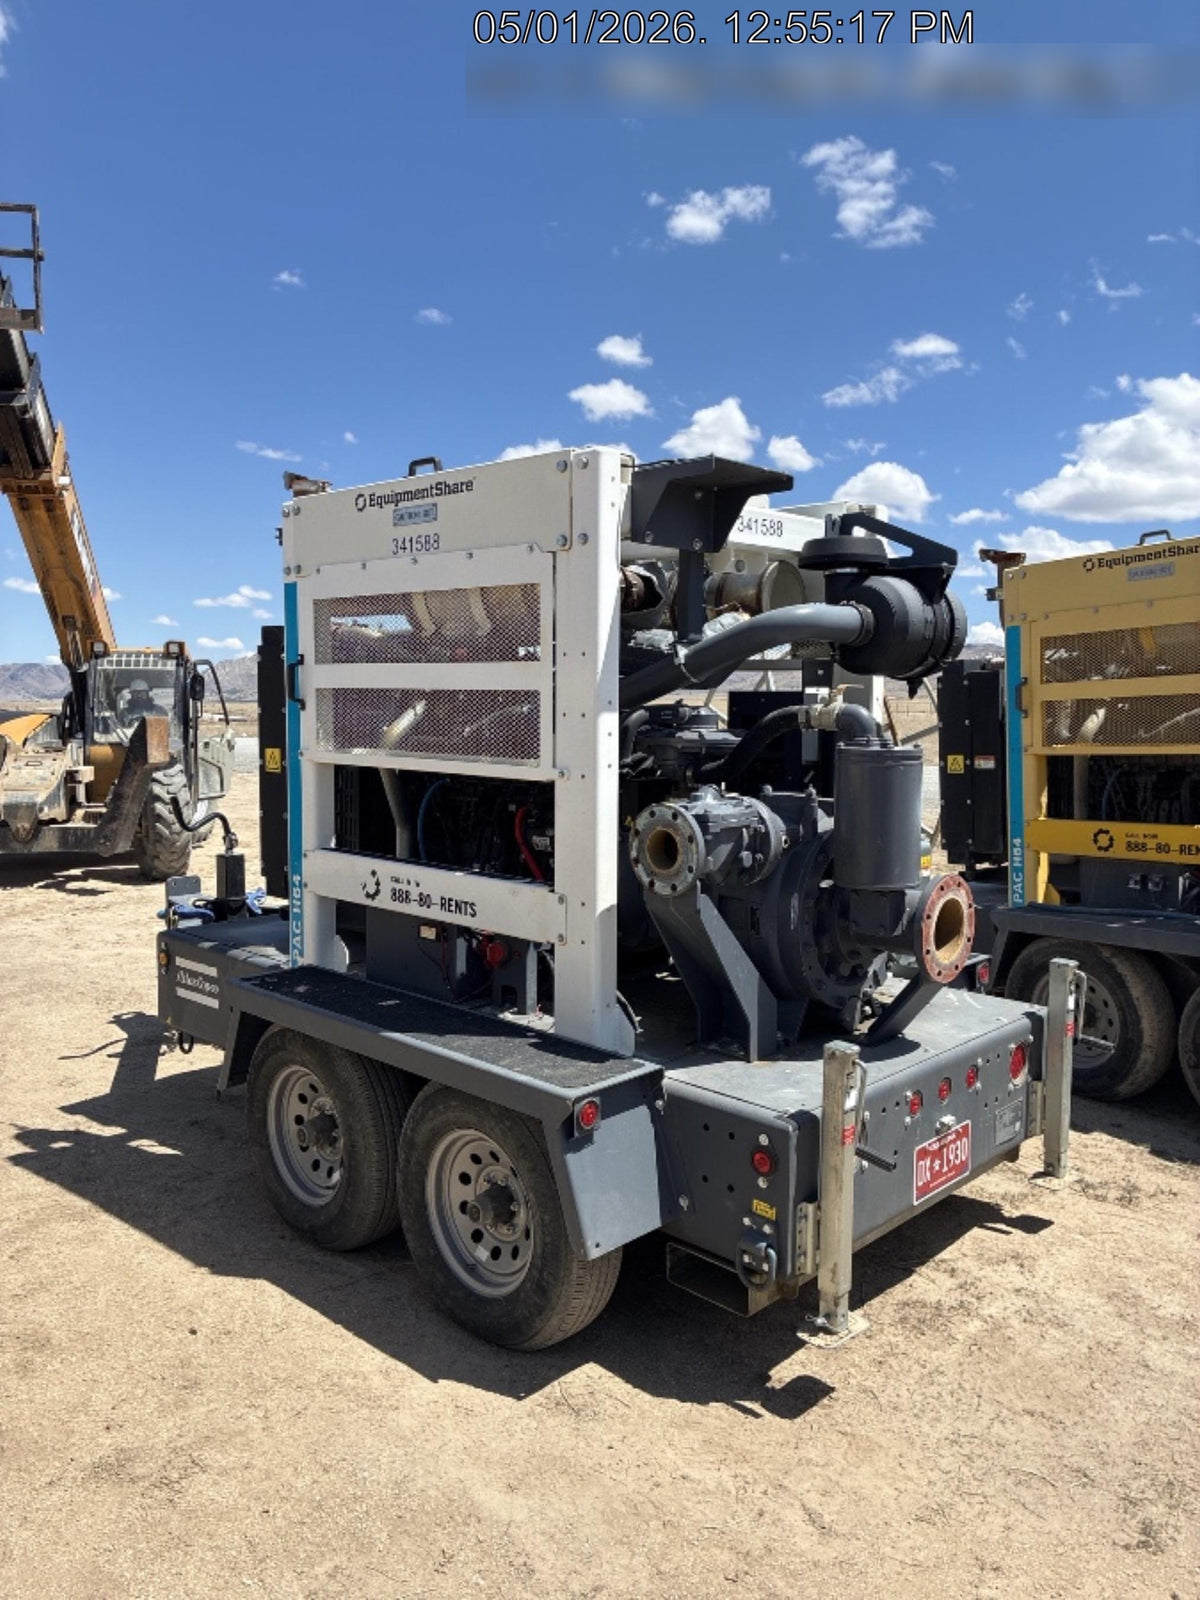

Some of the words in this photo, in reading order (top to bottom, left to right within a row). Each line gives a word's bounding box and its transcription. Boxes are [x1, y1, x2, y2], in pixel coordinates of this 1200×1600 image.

[368, 479, 474, 508] EquipmentShare
[738, 515, 783, 538] 341588
[392, 532, 440, 555] 341588
[390, 886, 477, 918] 888-80-RENTS
[1013, 872, 1024, 903] PAC
[292, 921, 302, 964] PAC
[942, 1137, 968, 1173] 1930
